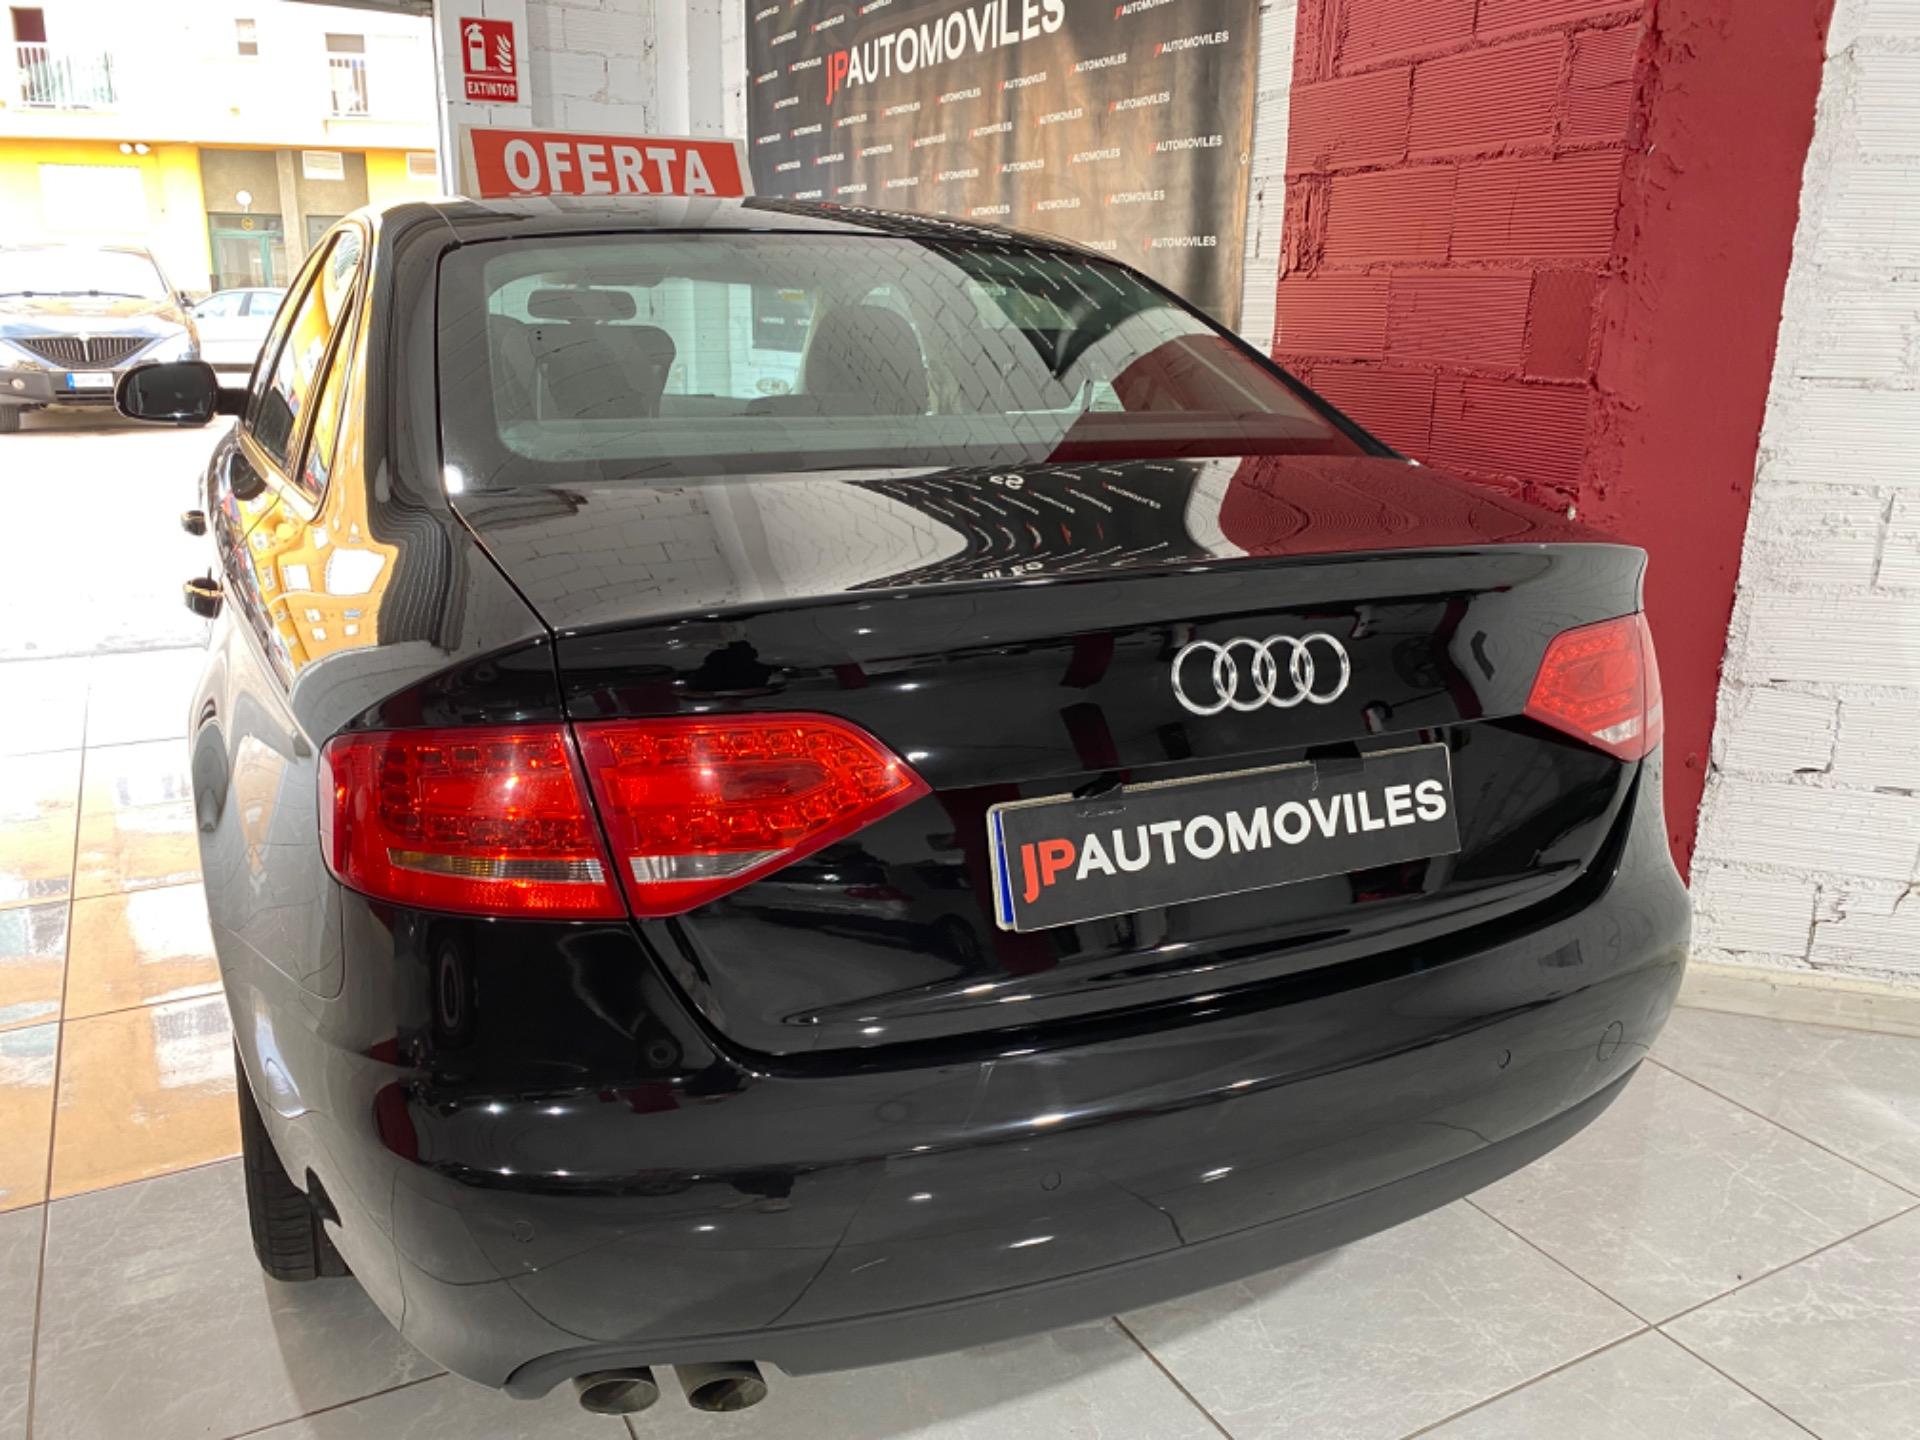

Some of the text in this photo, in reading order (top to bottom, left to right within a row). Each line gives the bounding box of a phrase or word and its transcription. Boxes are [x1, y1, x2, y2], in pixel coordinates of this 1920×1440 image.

[827, 0, 1065, 104] JPAUTOMOVILES
[468, 81, 515, 96] EXTINTOR
[998, 72, 1046, 91] AUTOMOVILES
[504, 139, 716, 194] OFERTA
[1020, 779, 1447, 904] JPAUTOMOVILES
